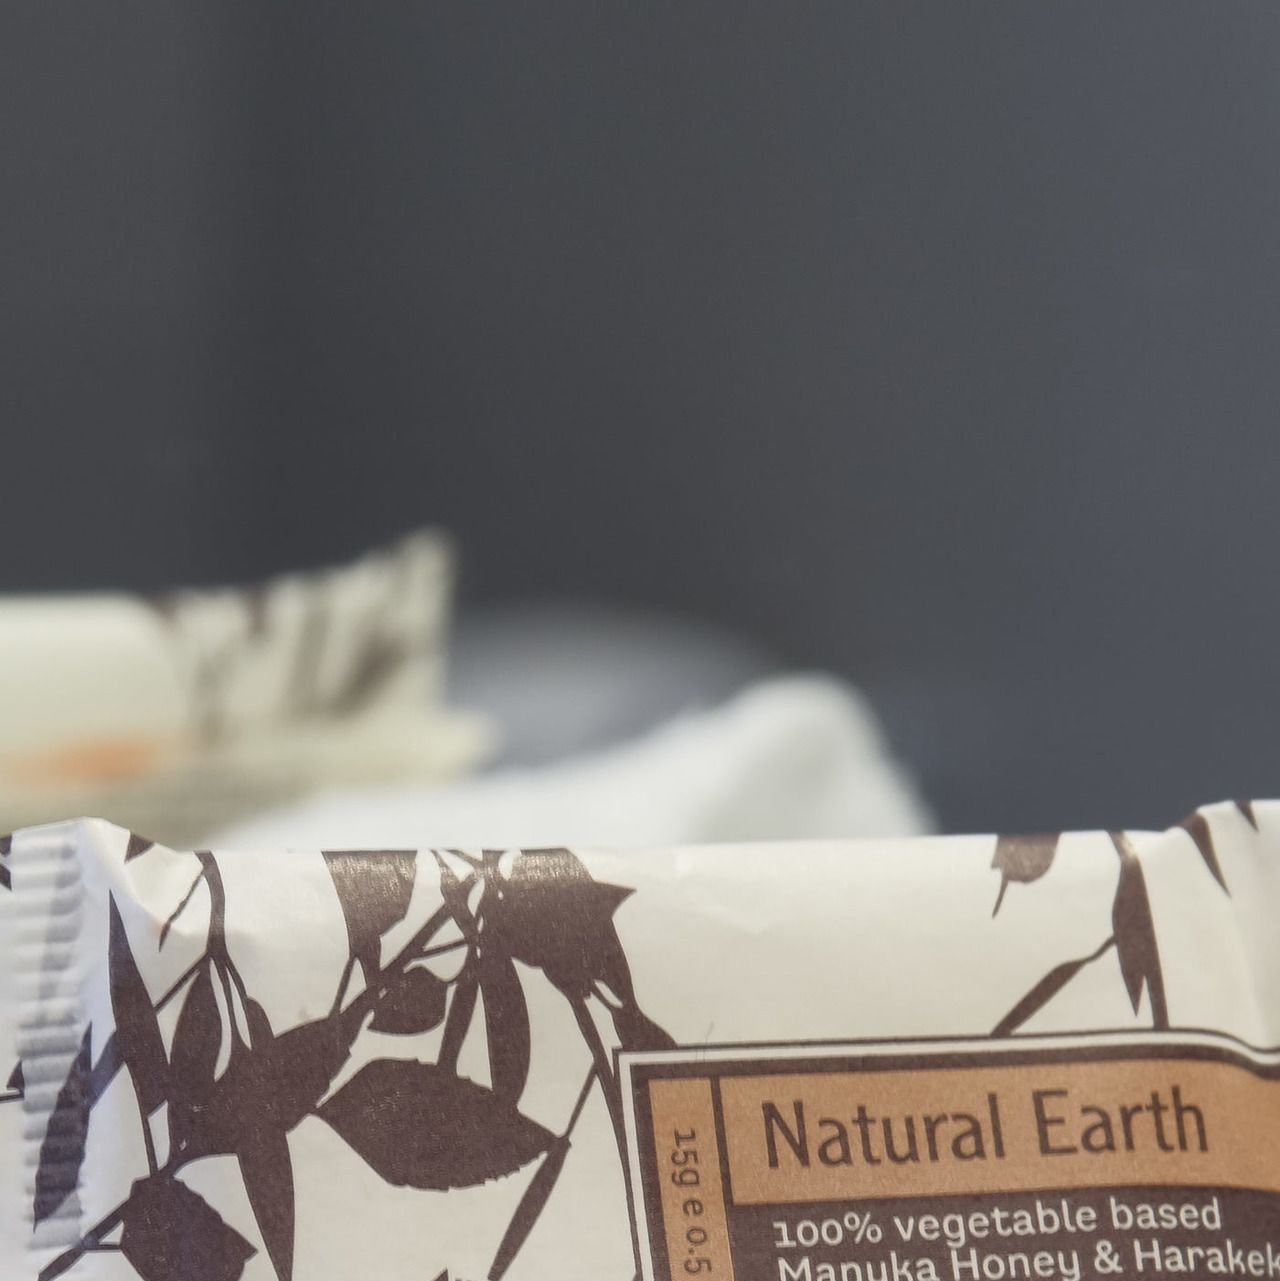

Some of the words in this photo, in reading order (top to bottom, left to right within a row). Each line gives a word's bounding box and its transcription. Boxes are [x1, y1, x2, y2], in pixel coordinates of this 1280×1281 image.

[761, 1092, 1005, 1168] Natural
[1032, 1085, 1209, 1155] Earth
[670, 1127, 700, 1187] 15g
[773, 1211, 883, 1249] 100%
[893, 1199, 1098, 1248] vegetable
[1109, 1196, 1221, 1230] based
[1094, 1239, 1123, 1275] &
